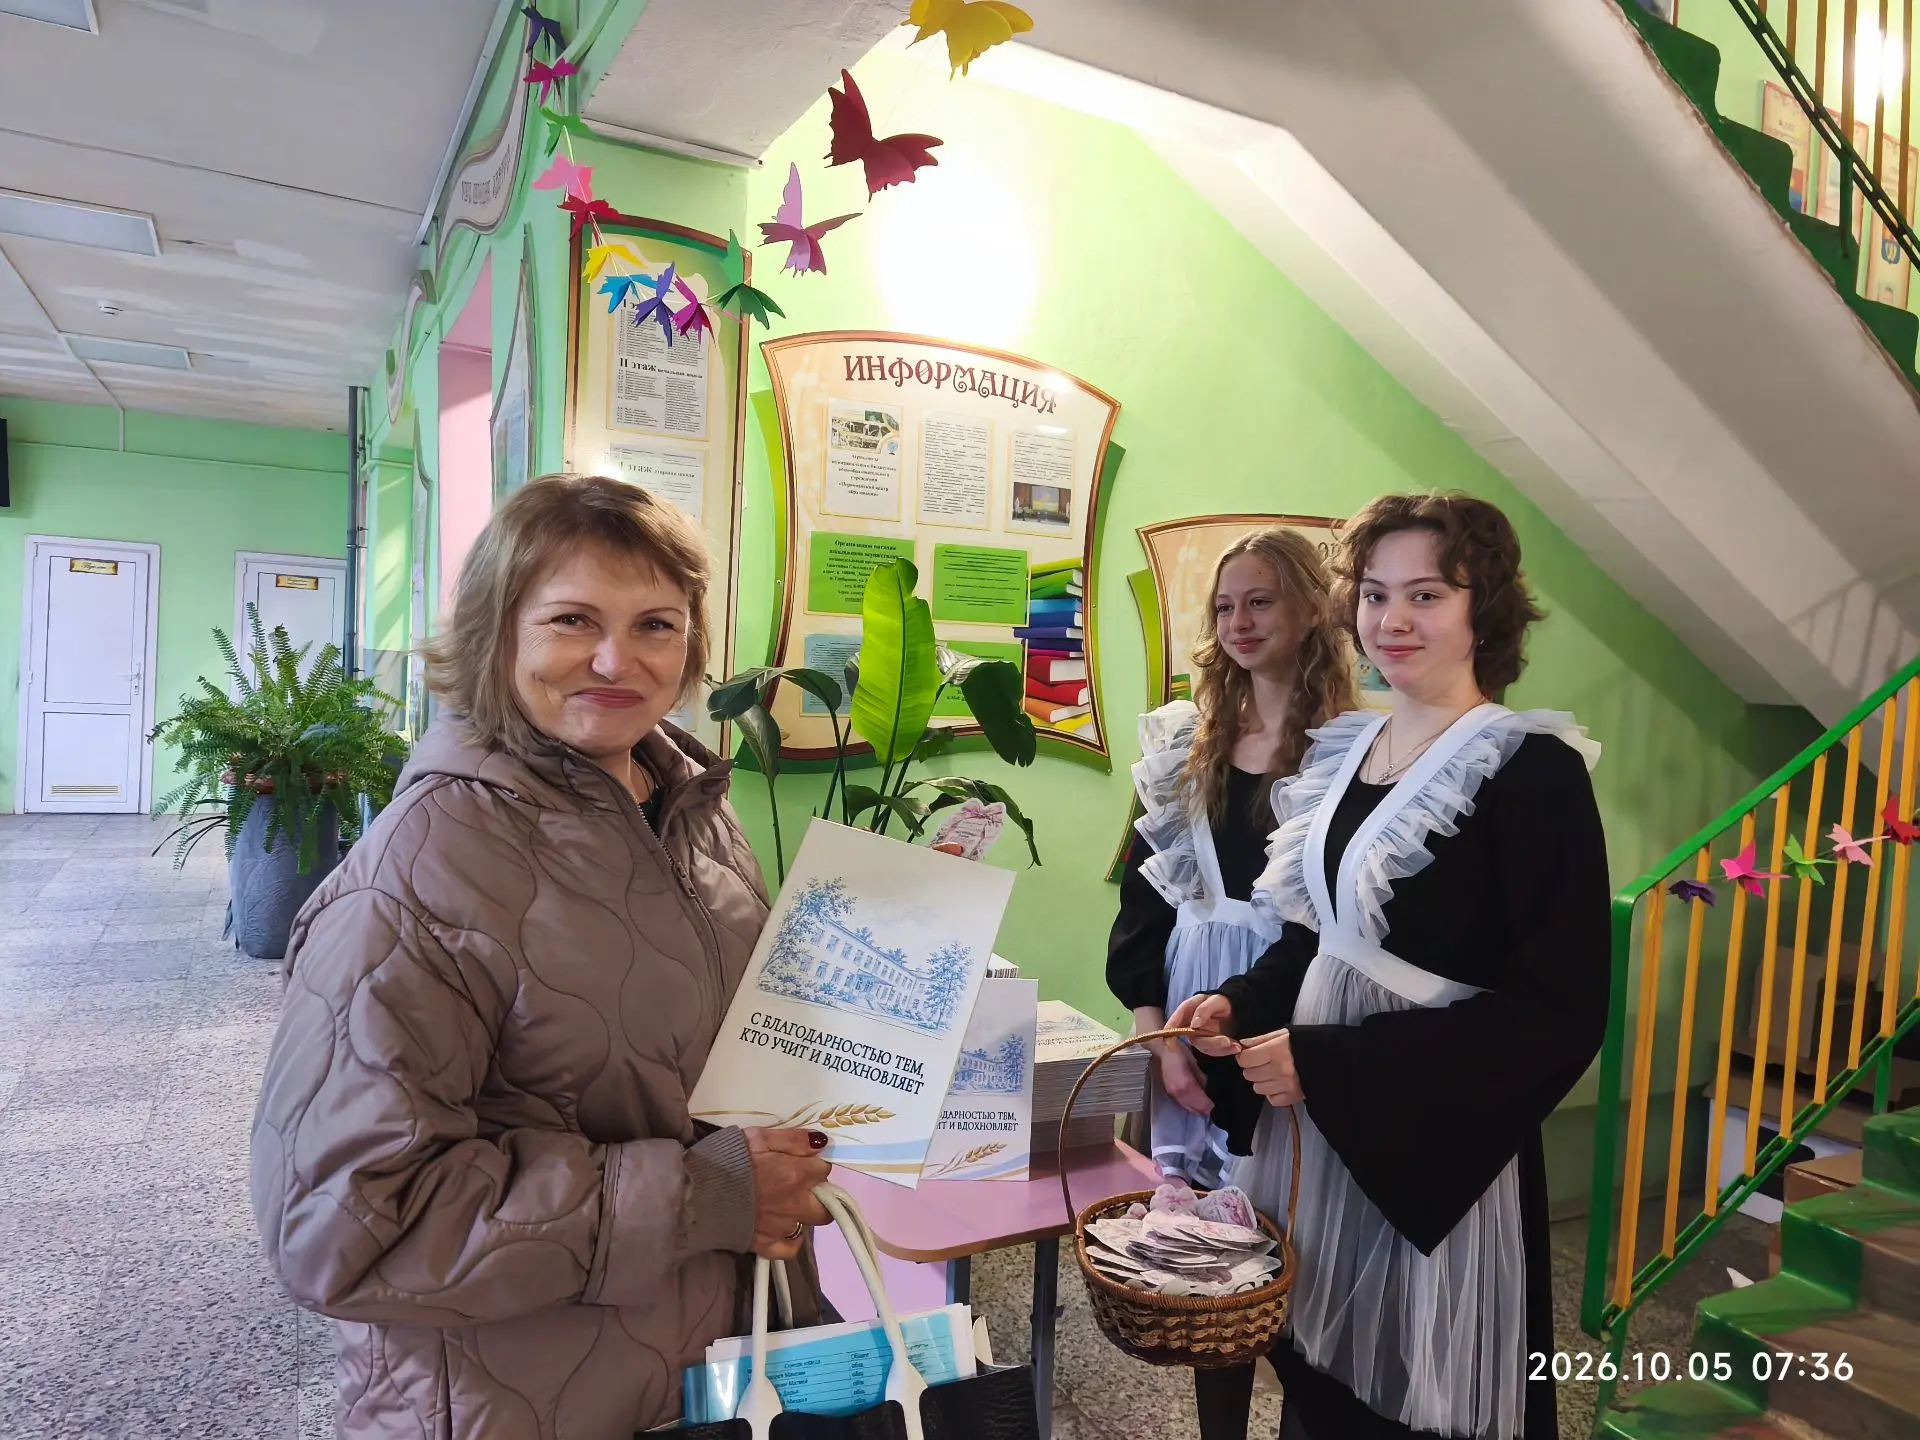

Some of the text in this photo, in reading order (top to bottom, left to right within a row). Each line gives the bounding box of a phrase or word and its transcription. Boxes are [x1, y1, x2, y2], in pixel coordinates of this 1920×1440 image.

[620, 357, 628, 368] II
[631, 361, 658, 373] этаж
[843, 355, 1057, 414] ИНФОРМАЦИЯ
[738, 1027, 925, 1095] КТО УЧИТ И ВДОХНОВЛЯЕТ
[750, 1012, 925, 1079] С БЛАГОДАРНОСТЬЮ ТЕМ,
[940, 1110, 996, 1120] ДАРНОСТЬЮ
[949, 1121, 955, 1130] И
[957, 1121, 1019, 1131] ВДОХНОВЛЯЕТ
